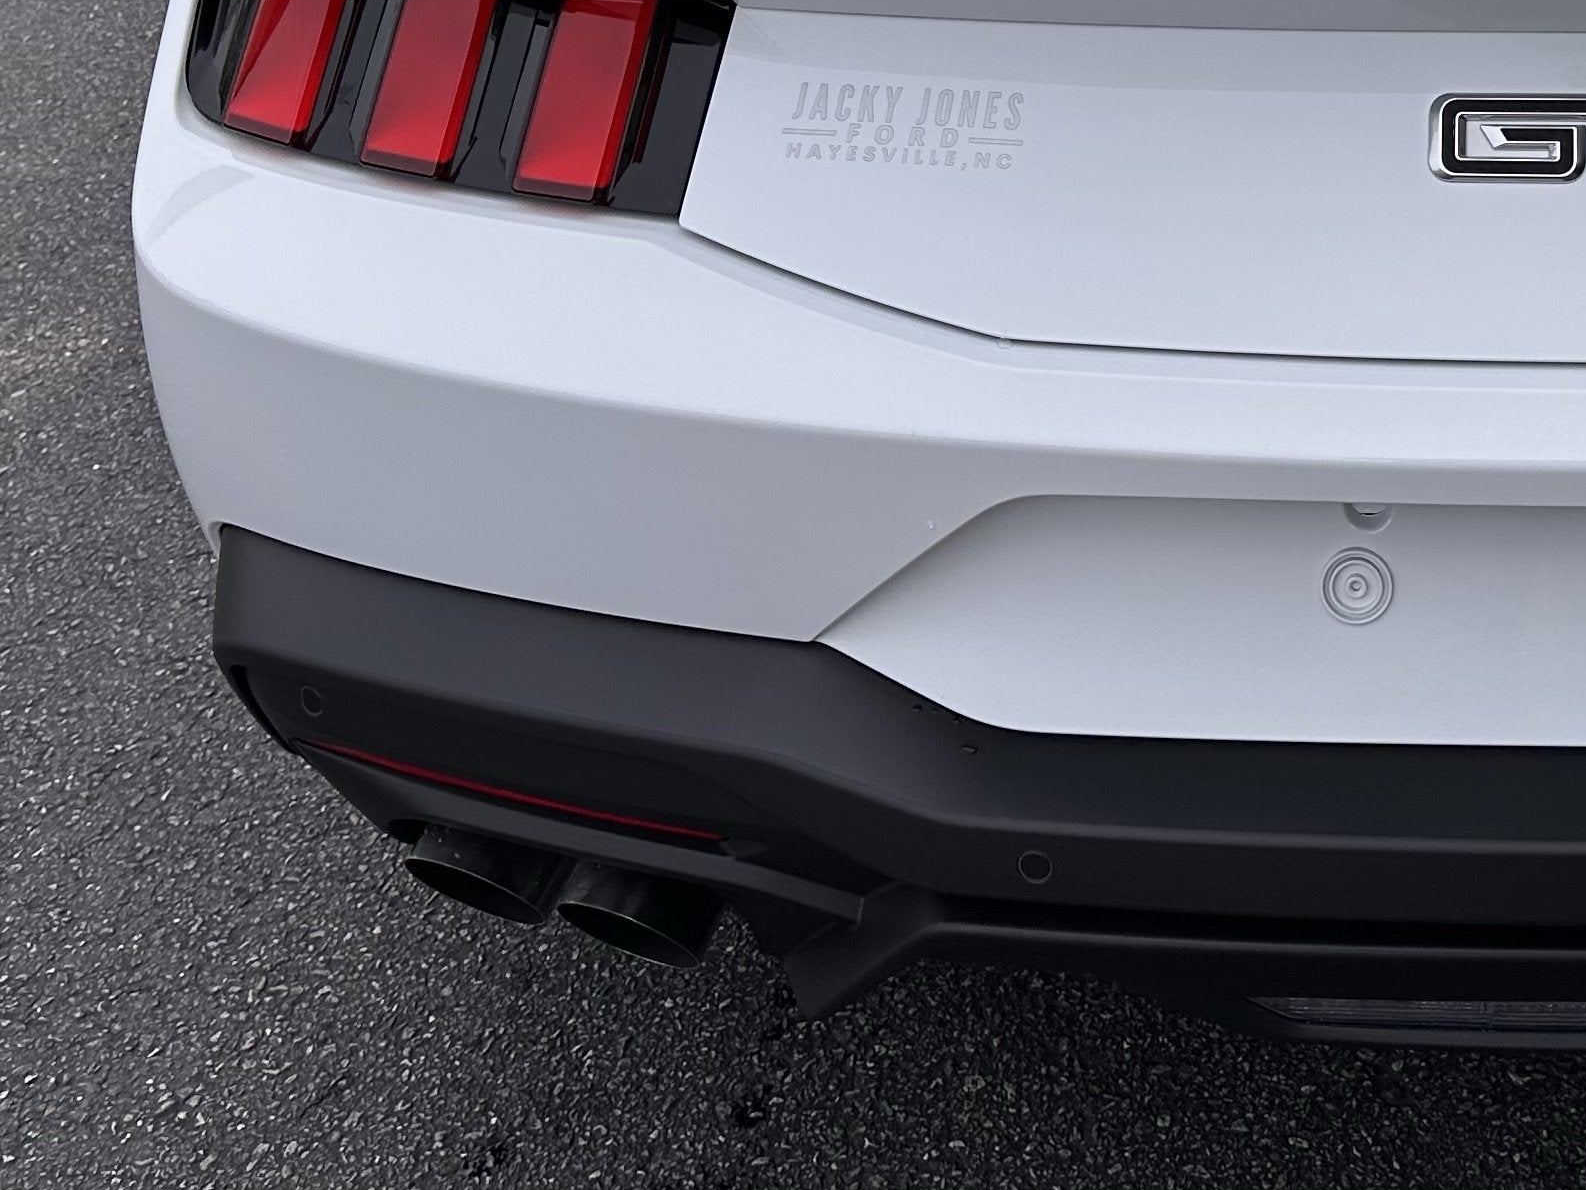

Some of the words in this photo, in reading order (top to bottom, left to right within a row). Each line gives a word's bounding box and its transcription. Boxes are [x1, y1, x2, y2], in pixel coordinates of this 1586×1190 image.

[792, 81, 904, 124] JACKY
[915, 87, 1025, 131] JONES
[846, 122, 960, 148] FORD
